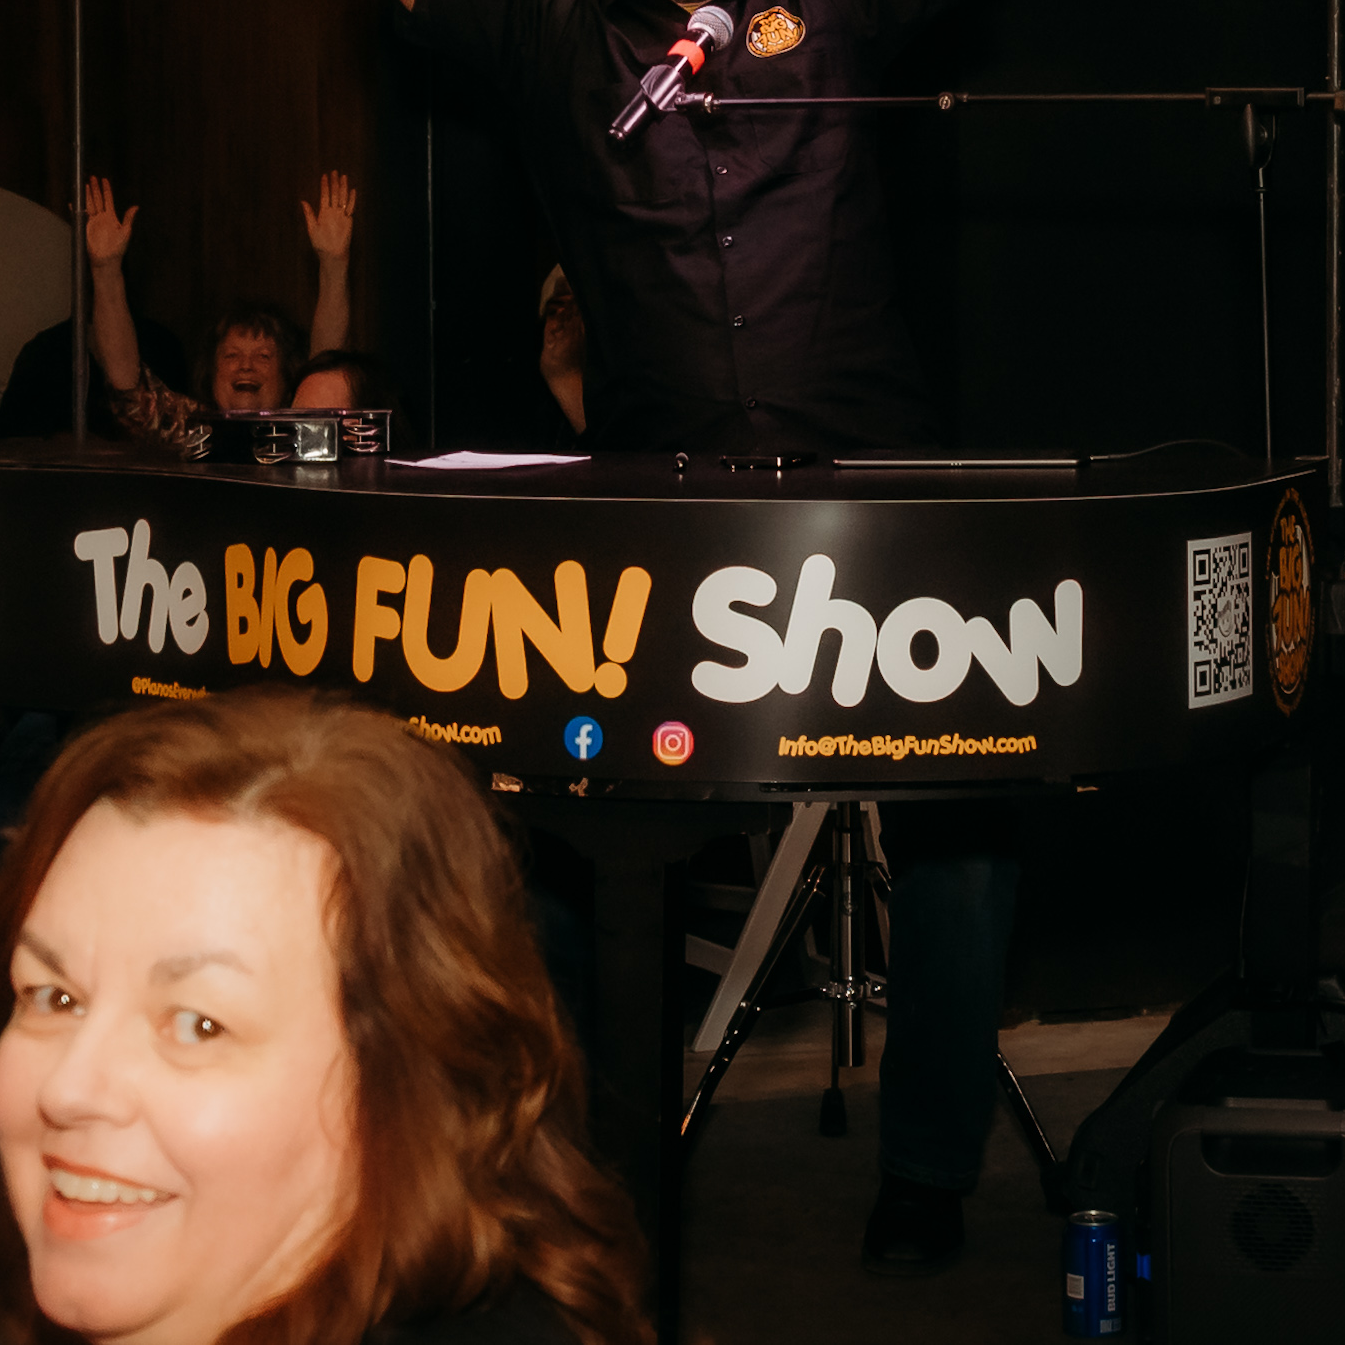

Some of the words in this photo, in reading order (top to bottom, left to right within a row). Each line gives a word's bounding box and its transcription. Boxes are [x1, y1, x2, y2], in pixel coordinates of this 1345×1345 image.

[1279, 541, 1303, 592] BIG
[74, 518, 209, 655] The
[225, 543, 329, 676] BIG
[352, 554, 652, 700] FUN!
[691, 554, 1084, 707] Show
[1107, 1243, 1116, 1282] LIGHT
[1107, 1284, 1116, 1312] BUD
